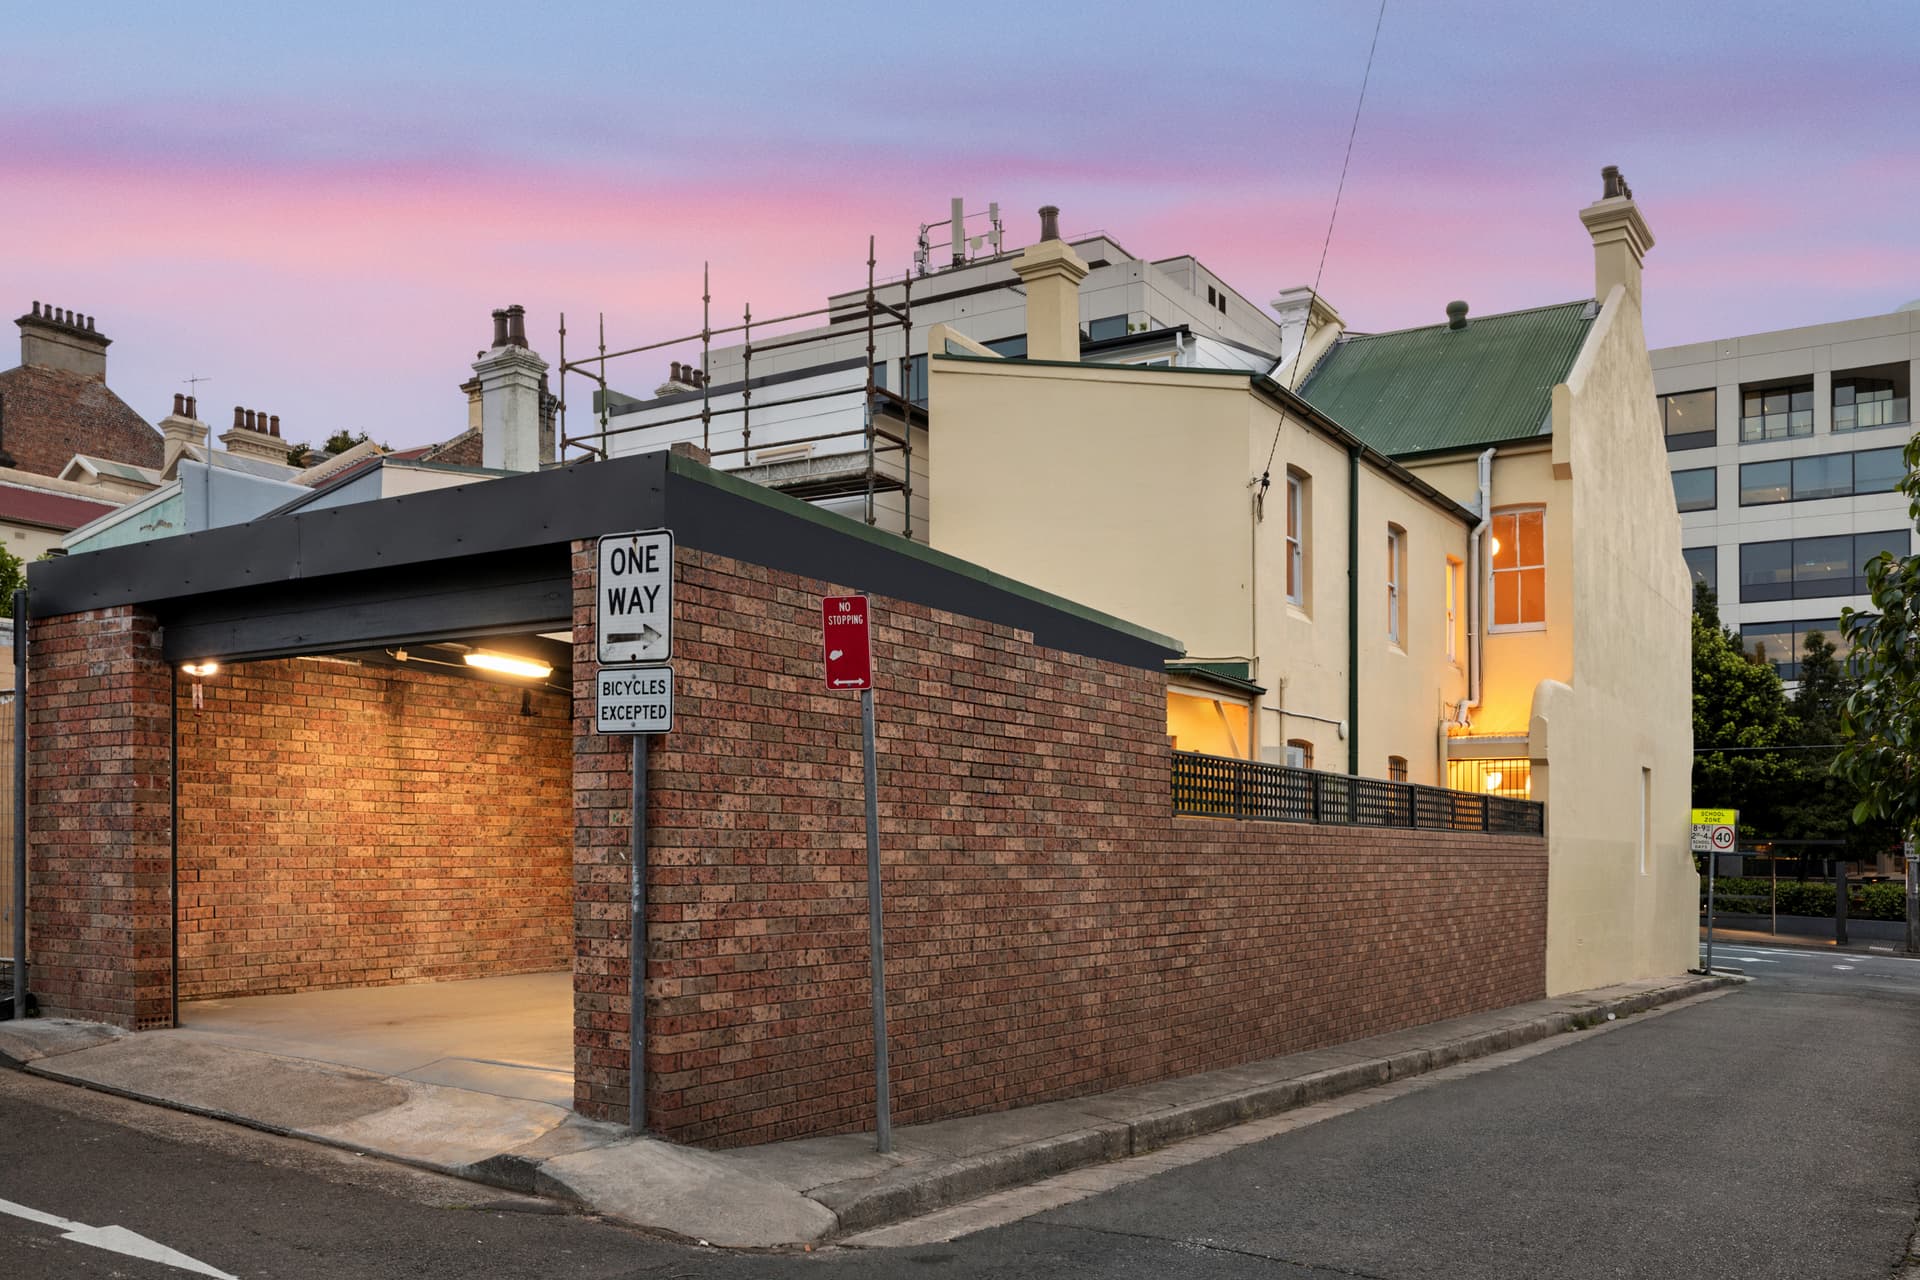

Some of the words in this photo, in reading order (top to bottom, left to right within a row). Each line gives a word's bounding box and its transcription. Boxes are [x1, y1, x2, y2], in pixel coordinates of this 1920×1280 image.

[611, 545, 659, 576] ONE
[608, 585, 661, 616] WAY
[839, 602, 851, 612] NO
[828, 615, 864, 625] STOPPING
[603, 680, 666, 696] BICYCLES
[601, 705, 667, 720] EXCEPTED
[1715, 832, 1731, 843] 40
